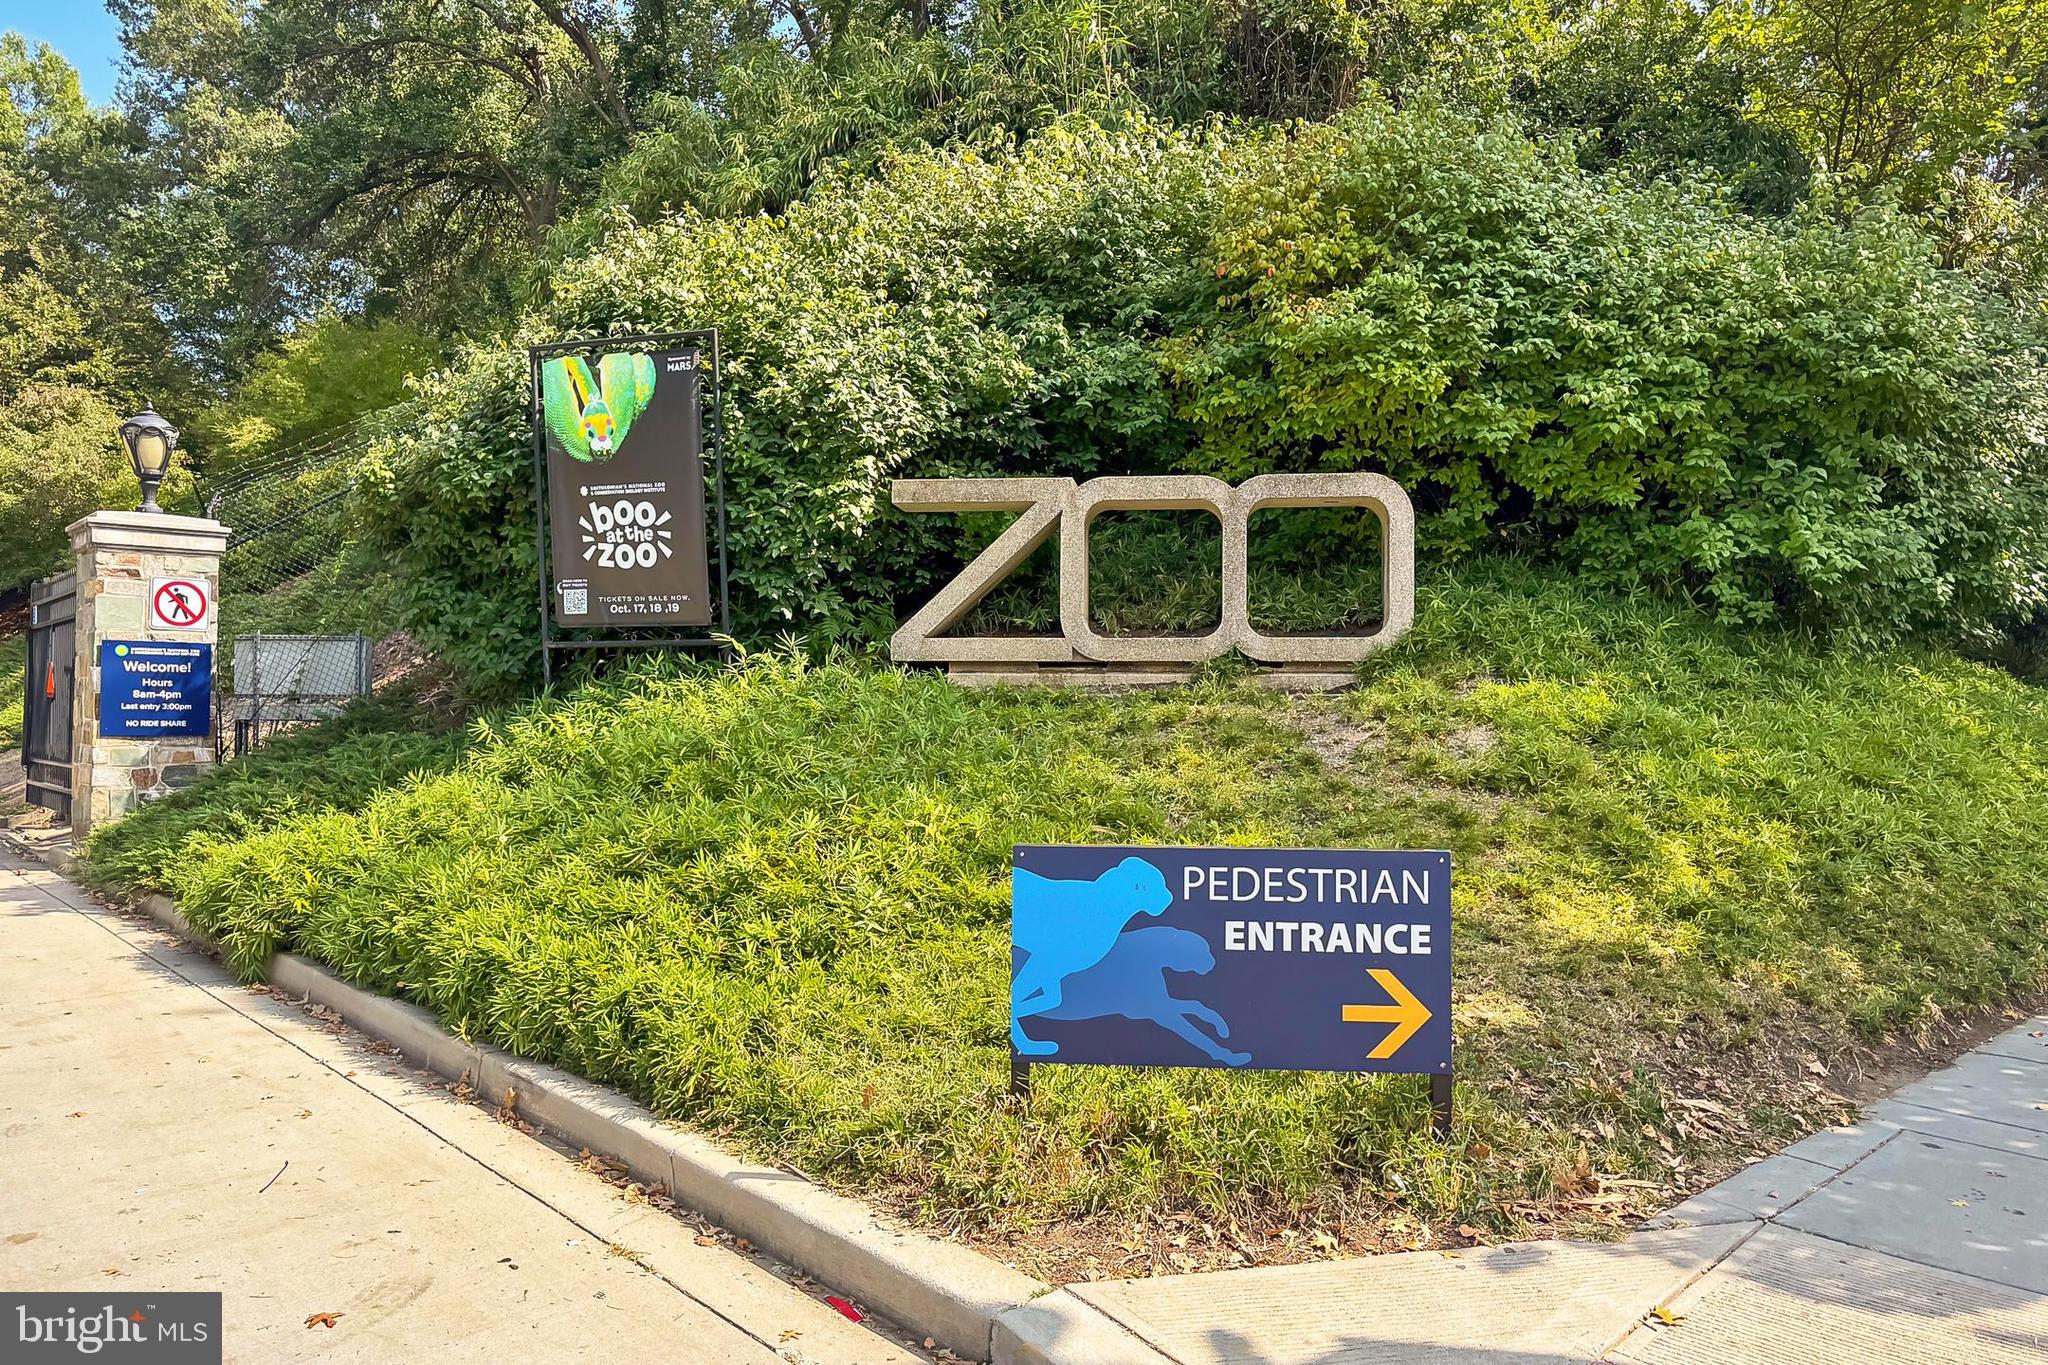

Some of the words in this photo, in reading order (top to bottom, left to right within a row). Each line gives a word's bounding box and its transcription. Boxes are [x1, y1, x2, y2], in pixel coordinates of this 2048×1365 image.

[667, 360, 691, 372] MARS
[606, 528, 624, 543] at
[625, 526, 653, 542] the
[891, 473, 1415, 662] ZOO
[610, 604, 631, 613] Oct.
[634, 603, 647, 614] 17,
[649, 603, 662, 613] 18
[123, 661, 191, 672] Welcome!
[142, 678, 173, 687] Hours
[133, 690, 181, 700] 8am-4pm
[139, 703, 160, 711] entry
[162, 703, 192, 711] 3:00pm
[125, 719, 139, 727] NO
[140, 719, 159, 727] RIDE
[1184, 867, 1428, 904] PEDESTRIAN
[1226, 921, 1431, 954] ENTRANCE
